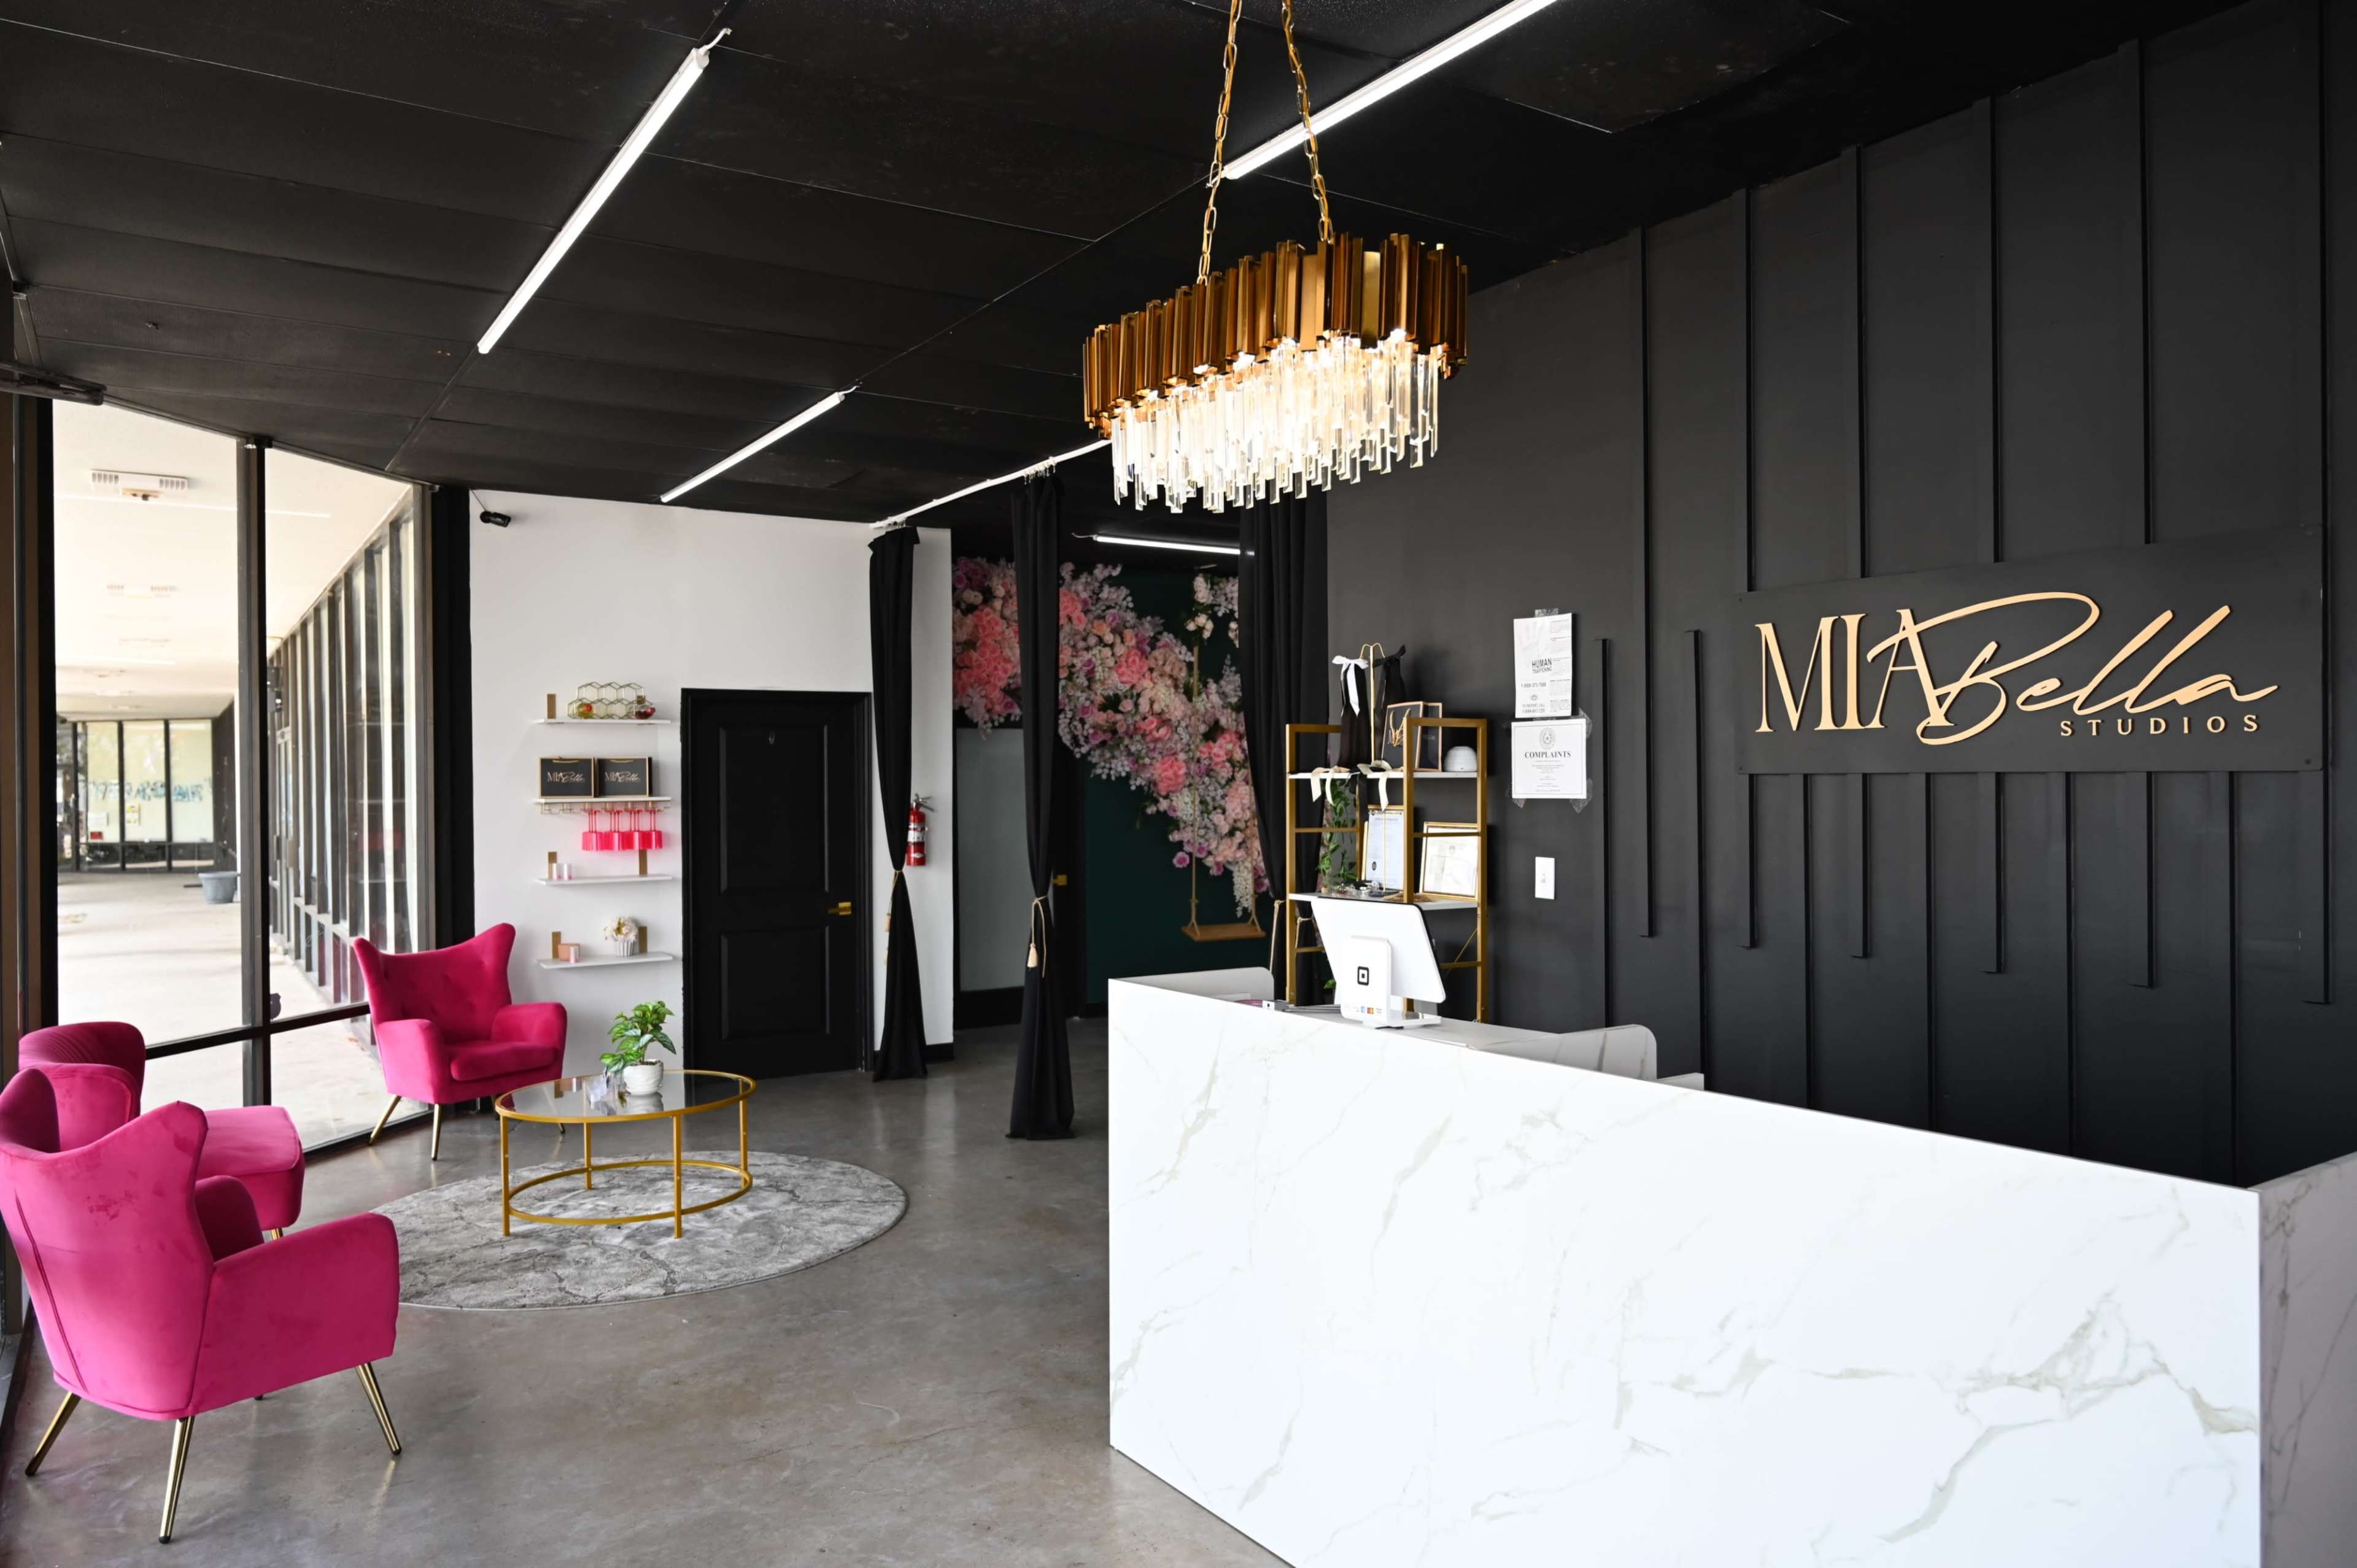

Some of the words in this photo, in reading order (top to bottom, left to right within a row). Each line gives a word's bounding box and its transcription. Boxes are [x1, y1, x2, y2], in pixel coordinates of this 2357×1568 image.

[1532, 658, 1552, 668] HUMAN
[1755, 609, 1955, 733] MIA
[1867, 591, 2278, 746] Bella
[2059, 714, 2260, 737] STUDIOS
